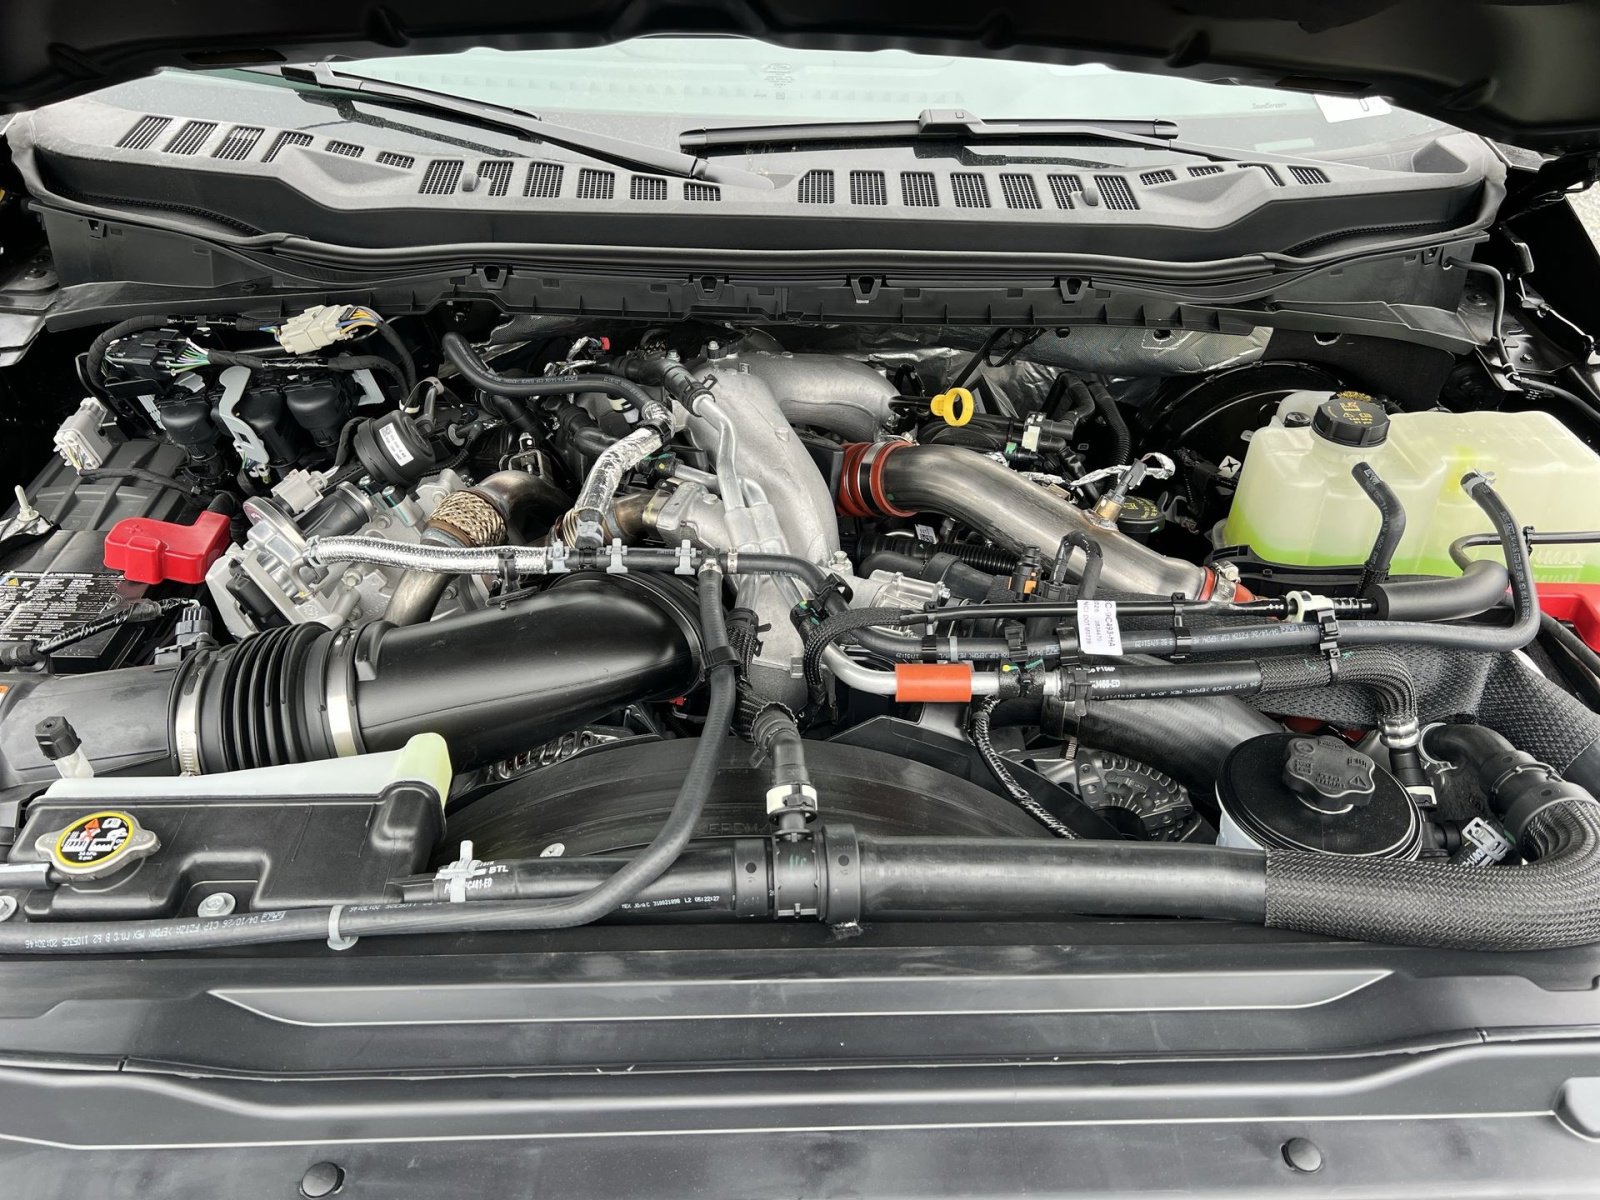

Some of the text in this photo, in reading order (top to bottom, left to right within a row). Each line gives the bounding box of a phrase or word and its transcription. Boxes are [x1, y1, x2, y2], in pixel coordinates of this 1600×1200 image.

[488, 865, 510, 875] BTL
[203, 920, 219, 932] CIP
[25, 938, 58, 950] 20:30:46
